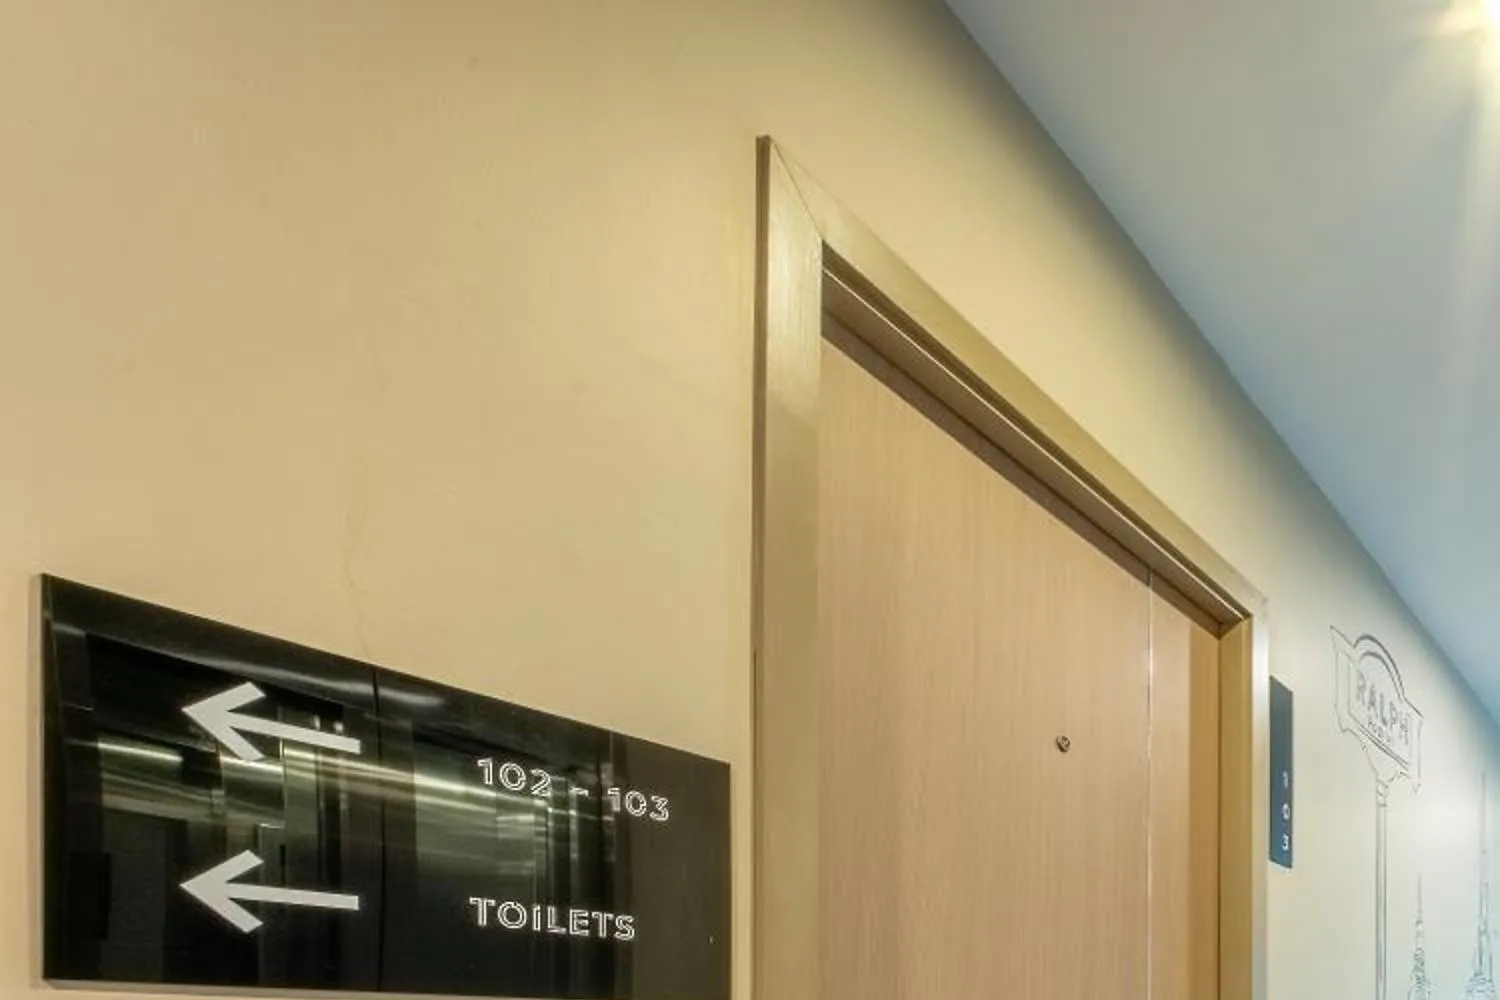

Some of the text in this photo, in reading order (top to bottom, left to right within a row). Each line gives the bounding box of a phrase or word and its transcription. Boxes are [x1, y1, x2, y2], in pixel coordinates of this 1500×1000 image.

[477, 757, 551, 797] 102
[607, 787, 670, 822] 103
[469, 896, 636, 941] TOILETS
